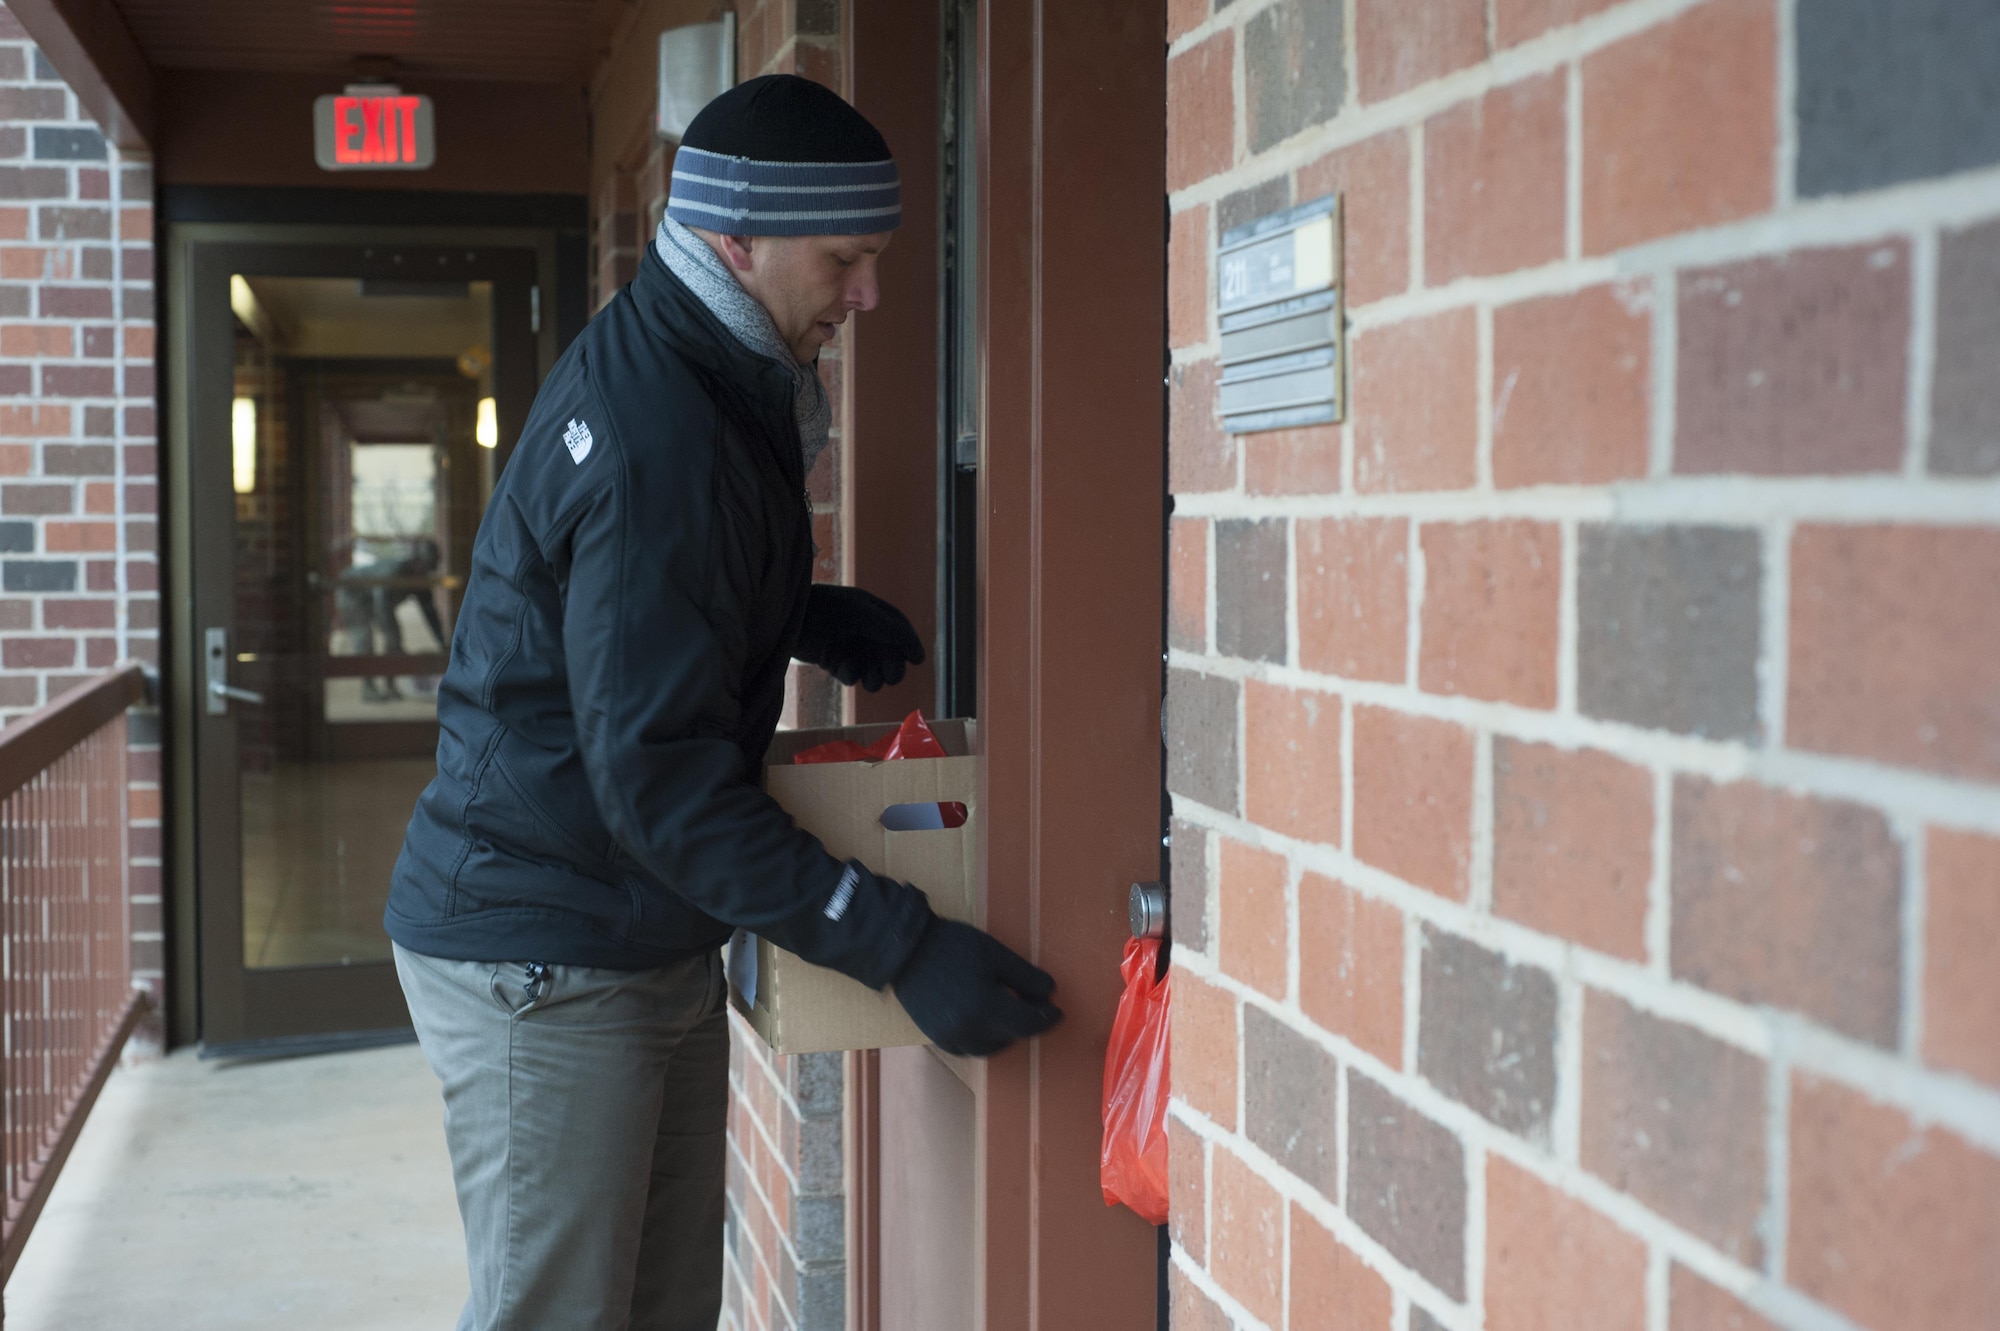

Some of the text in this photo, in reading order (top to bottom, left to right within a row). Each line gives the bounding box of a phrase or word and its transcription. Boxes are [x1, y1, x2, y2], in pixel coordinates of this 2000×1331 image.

[334, 96, 420, 164] EXIT
[1224, 257, 1247, 300] 211
[577, 420, 591, 439] THE
